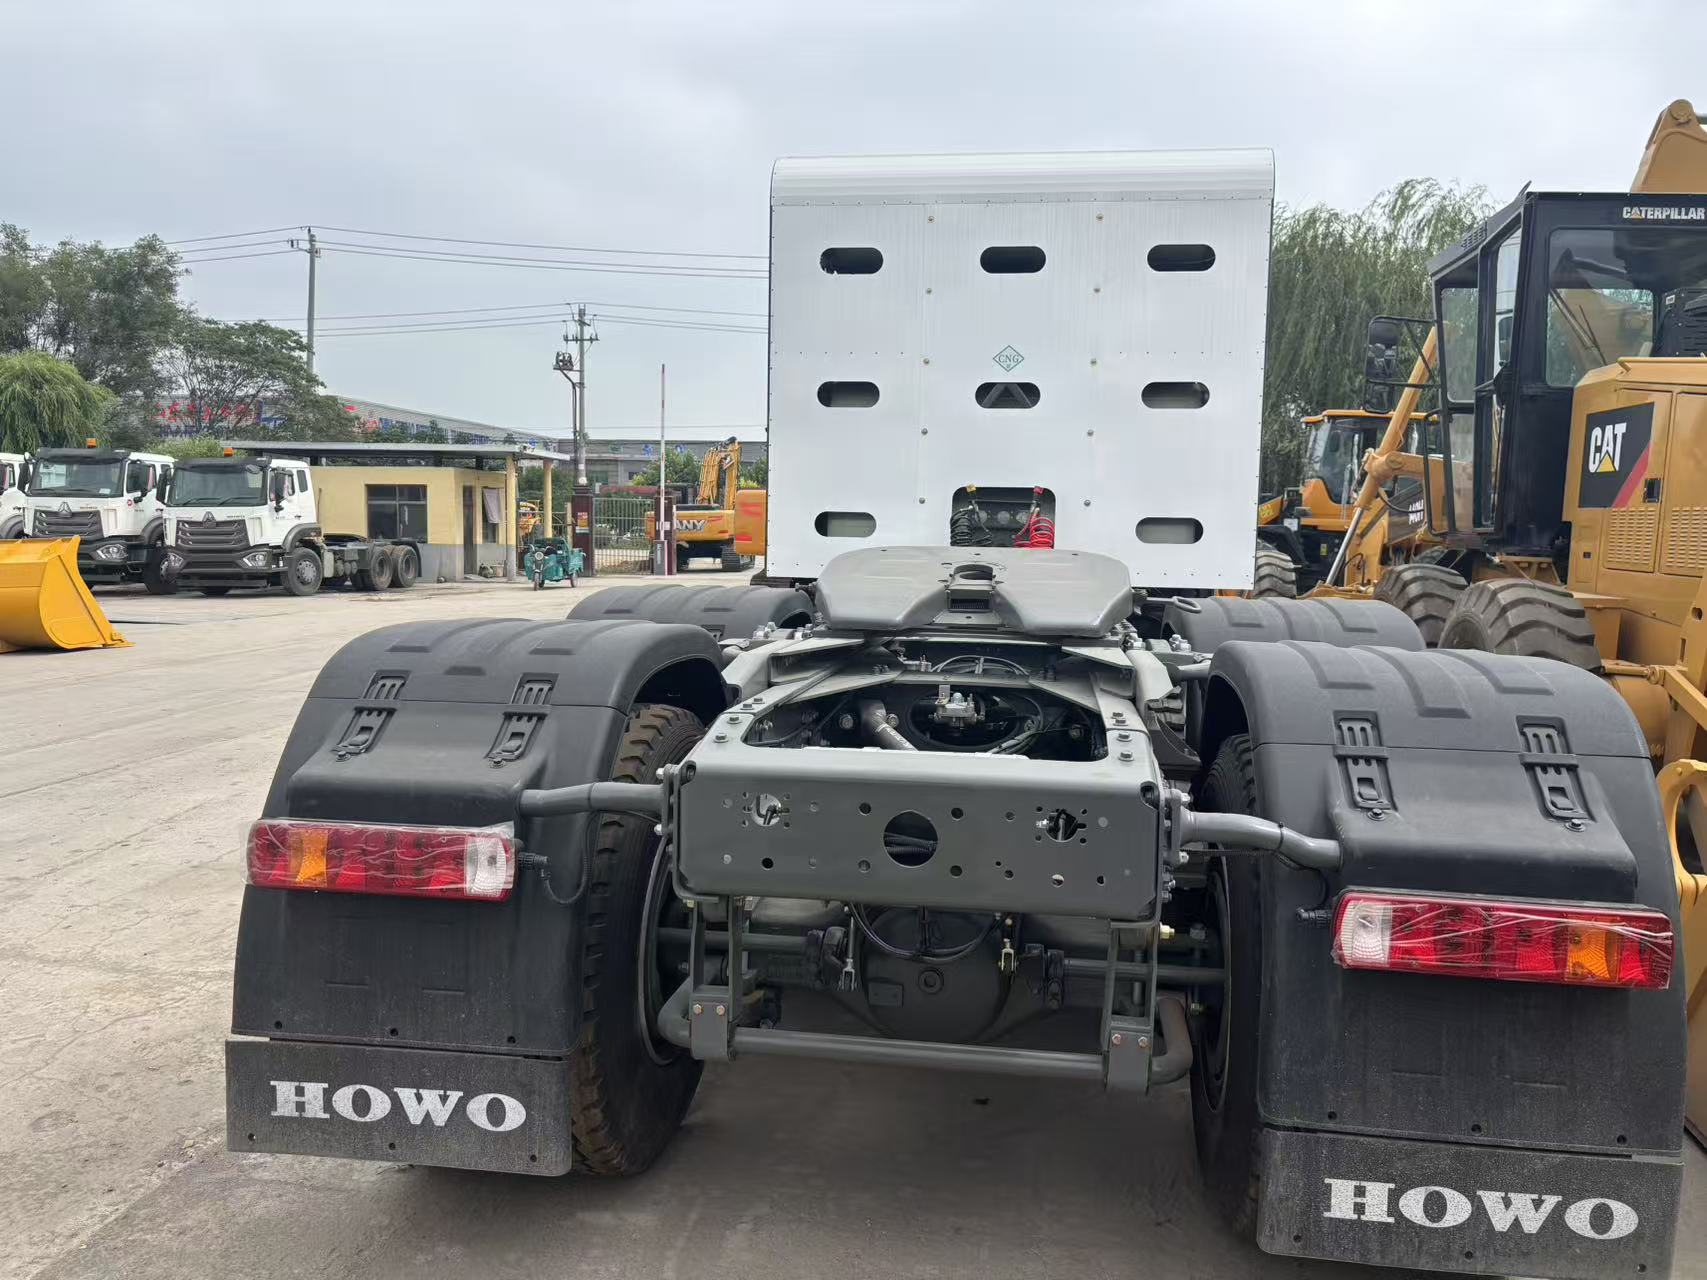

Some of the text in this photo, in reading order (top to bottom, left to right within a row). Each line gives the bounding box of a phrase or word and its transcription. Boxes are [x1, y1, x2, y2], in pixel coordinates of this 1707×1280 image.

[1622, 206, 1705, 220] CATERPILLAR
[998, 354, 1019, 363] CNG
[1588, 422, 1627, 473] CAT
[675, 519, 706, 531] ANY
[269, 1080, 527, 1132] HOWO
[1323, 1178, 1639, 1240] HOWO
